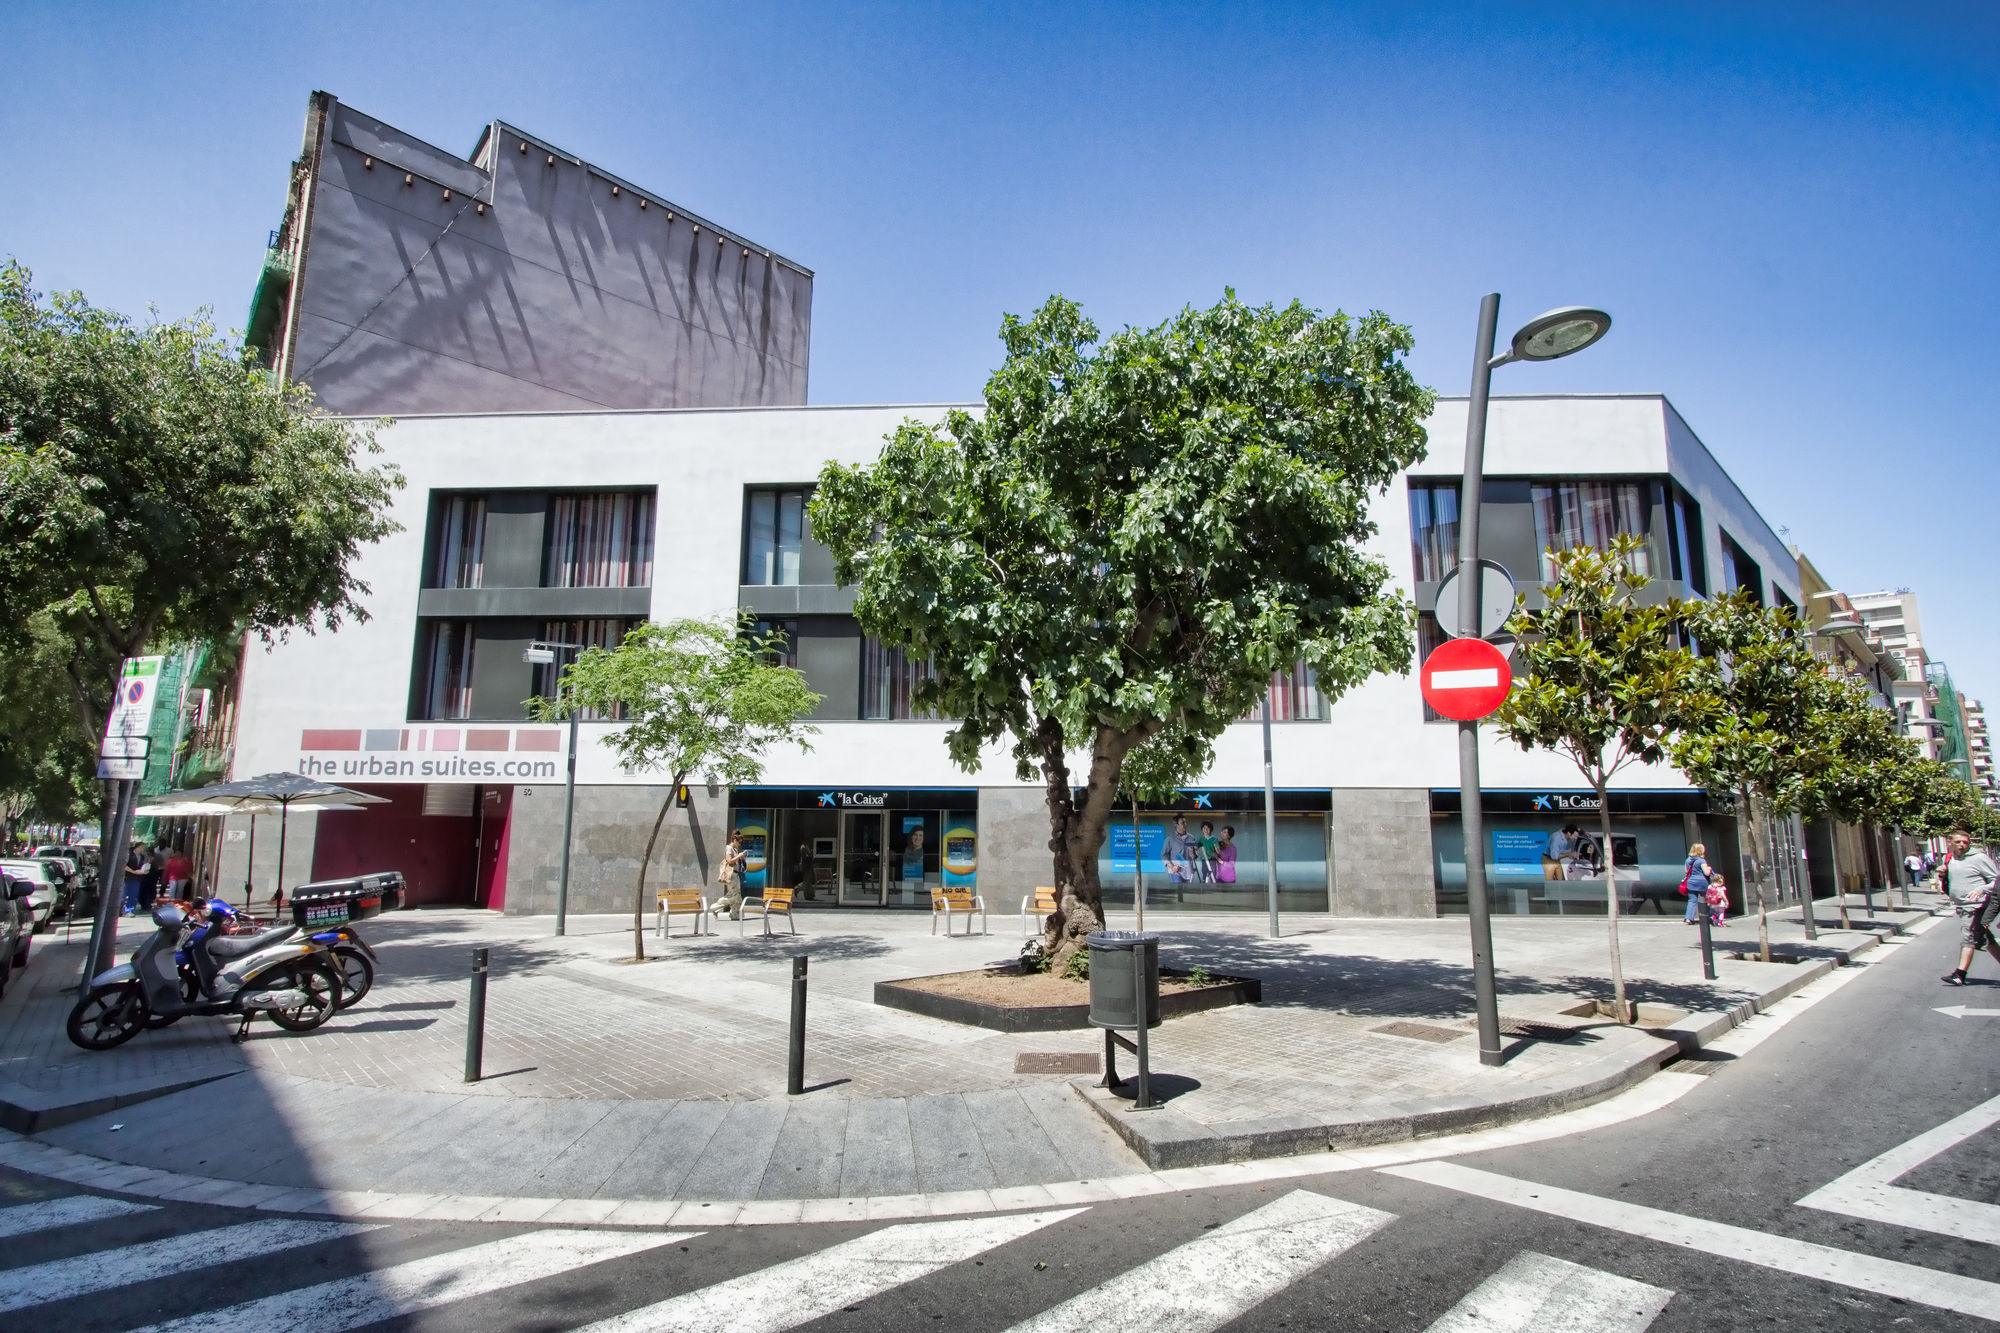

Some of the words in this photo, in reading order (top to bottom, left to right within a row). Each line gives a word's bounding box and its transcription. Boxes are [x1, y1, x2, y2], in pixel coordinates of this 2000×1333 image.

[299, 756, 337, 776] the
[343, 756, 414, 776] urban
[421, 757, 555, 777] suites.com
